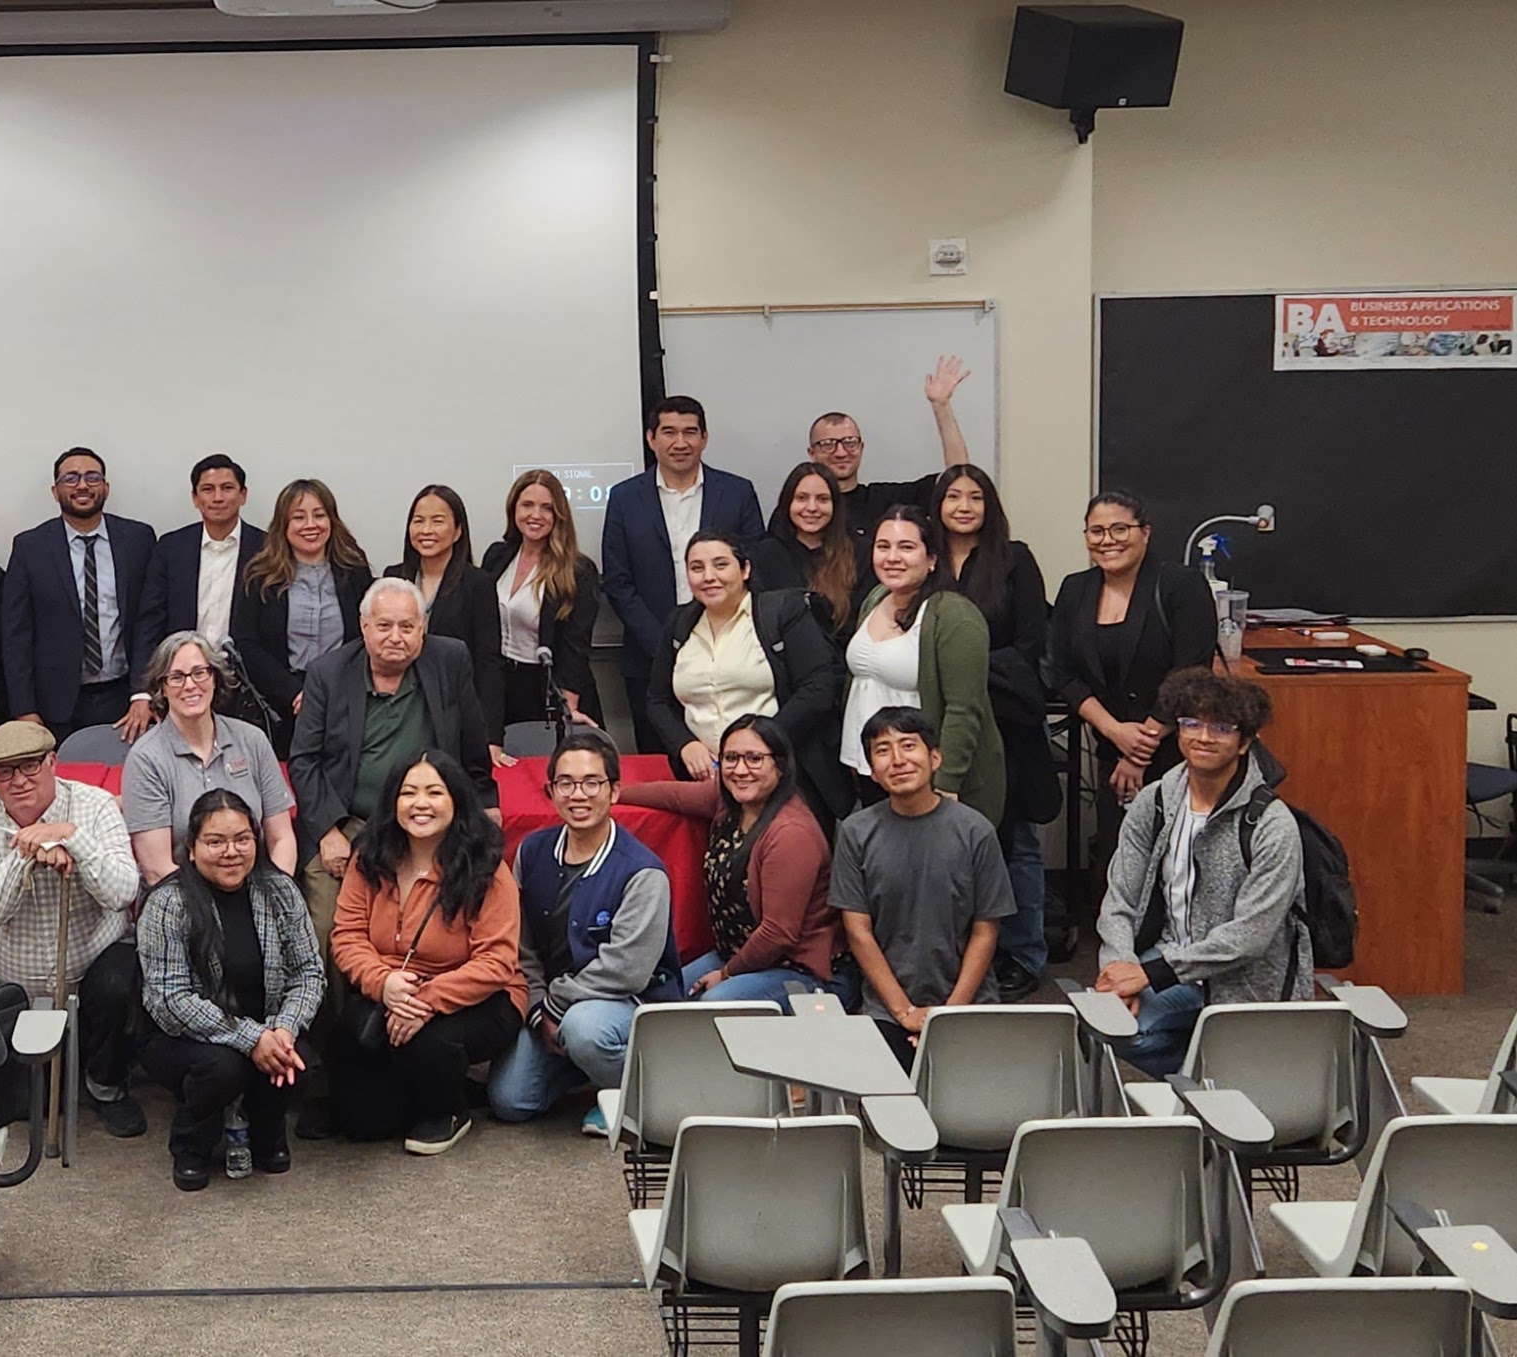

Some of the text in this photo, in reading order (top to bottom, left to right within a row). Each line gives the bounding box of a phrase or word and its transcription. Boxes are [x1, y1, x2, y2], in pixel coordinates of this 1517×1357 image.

[1350, 299, 1501, 312] BUSINESS APPLICATIONS
[1287, 302, 1348, 334] BA
[1350, 315, 1450, 326] & TECHNOLOGY
[564, 469, 595, 479] SIGNAL
